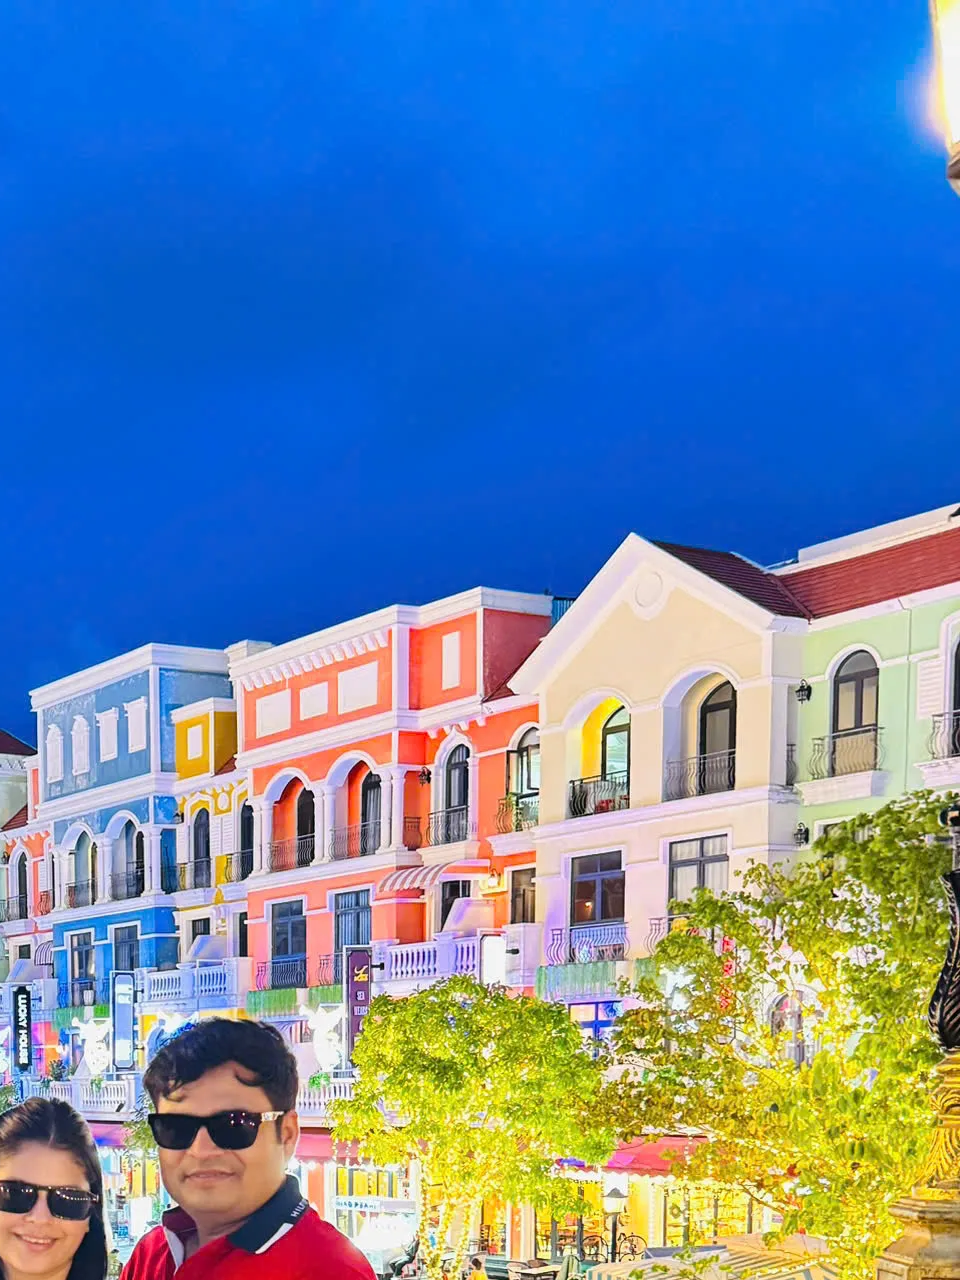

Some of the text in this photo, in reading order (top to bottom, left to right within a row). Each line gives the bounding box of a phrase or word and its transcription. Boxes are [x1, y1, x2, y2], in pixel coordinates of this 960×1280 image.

[18, 994, 28, 1064] LUCKY HOUSE
[290, 1199, 307, 1217] HILF
